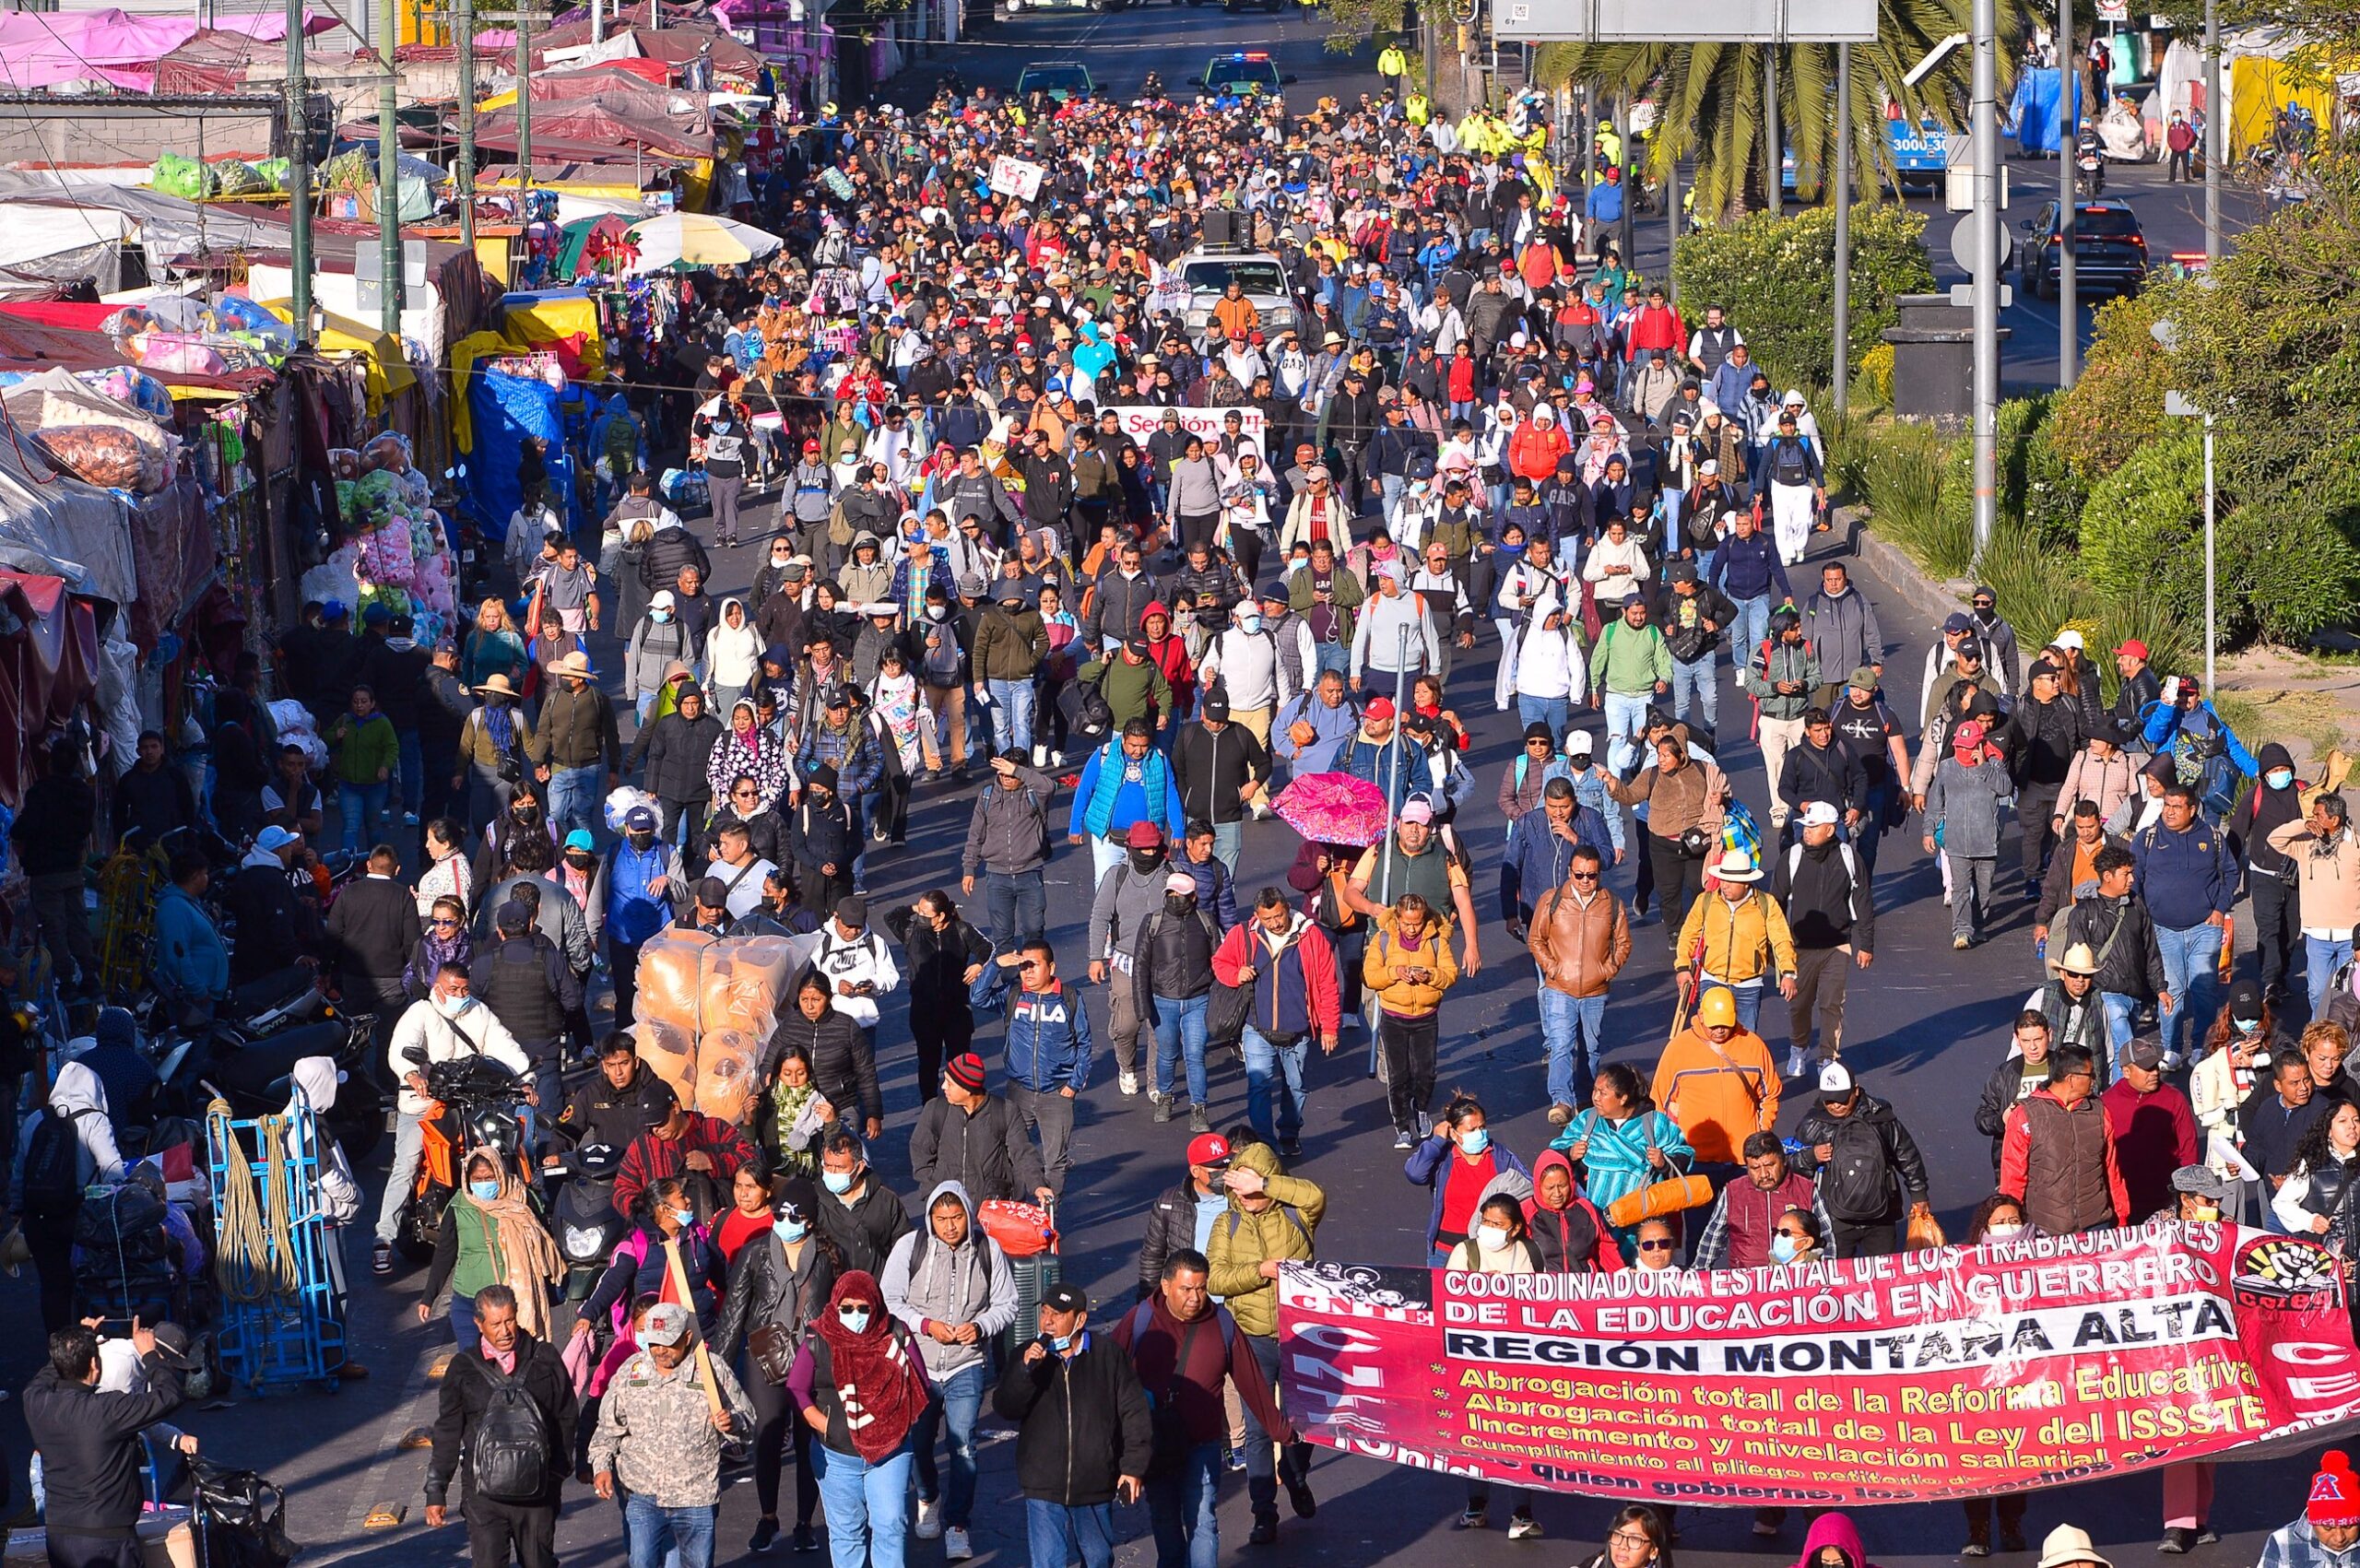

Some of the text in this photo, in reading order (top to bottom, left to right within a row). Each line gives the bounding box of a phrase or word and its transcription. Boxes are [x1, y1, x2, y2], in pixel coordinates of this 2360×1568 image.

[1281, 360, 1305, 371] GAP
[1128, 414, 1216, 433] Seción
[800, 478, 824, 489] NASA
[1549, 489, 1576, 506] GAP
[1315, 580, 1331, 590] GAP
[1014, 1001, 1068, 1023] FILA
[1444, 1269, 1704, 1302] COORDINADORA
[1710, 1257, 1848, 1298] ESTATAL
[1853, 1255, 1896, 1284] DE
[1902, 1244, 1962, 1276] LOS
[1976, 1220, 2223, 1266] TRABAJADORES
[1444, 1301, 1508, 1326] DE
[1519, 1305, 1585, 1333] LA
[1596, 1287, 1879, 1334] EDUCACIÓN
[1890, 1279, 1953, 1318] EN
[1965, 1251, 2221, 1305] GUERRERO
[1446, 1333, 1700, 1373] REGIÓN
[2071, 1298, 2235, 1348] ALTA
[1458, 1353, 2261, 1414] Abrogación total de la Reforma Educativa
[1464, 1393, 1710, 1430] Abrogación
[1719, 1413, 1820, 1438] total
[1831, 1419, 1885, 1442] de
[1895, 1421, 1939, 1445] la
[1949, 1421, 2027, 1451] Ley
[2037, 1410, 2105, 1446] del
[2115, 1395, 2270, 1442] ISSSTE
[1467, 1413, 1698, 1451] Incremento
[1707, 1436, 1733, 1456] y
[1742, 1437, 1949, 1468] nivelación
[1958, 1447, 2109, 1469] salarial
[1459, 1434, 1668, 1469] Cumplimiento
[1674, 1458, 1705, 1472] al
[1710, 1458, 1805, 1479] pliego
[1811, 1469, 1941, 1486] petitorio
[1530, 1462, 1642, 1491] quien
[1651, 1480, 1847, 1503] gobierne,
[1852, 1486, 1918, 1500] los
